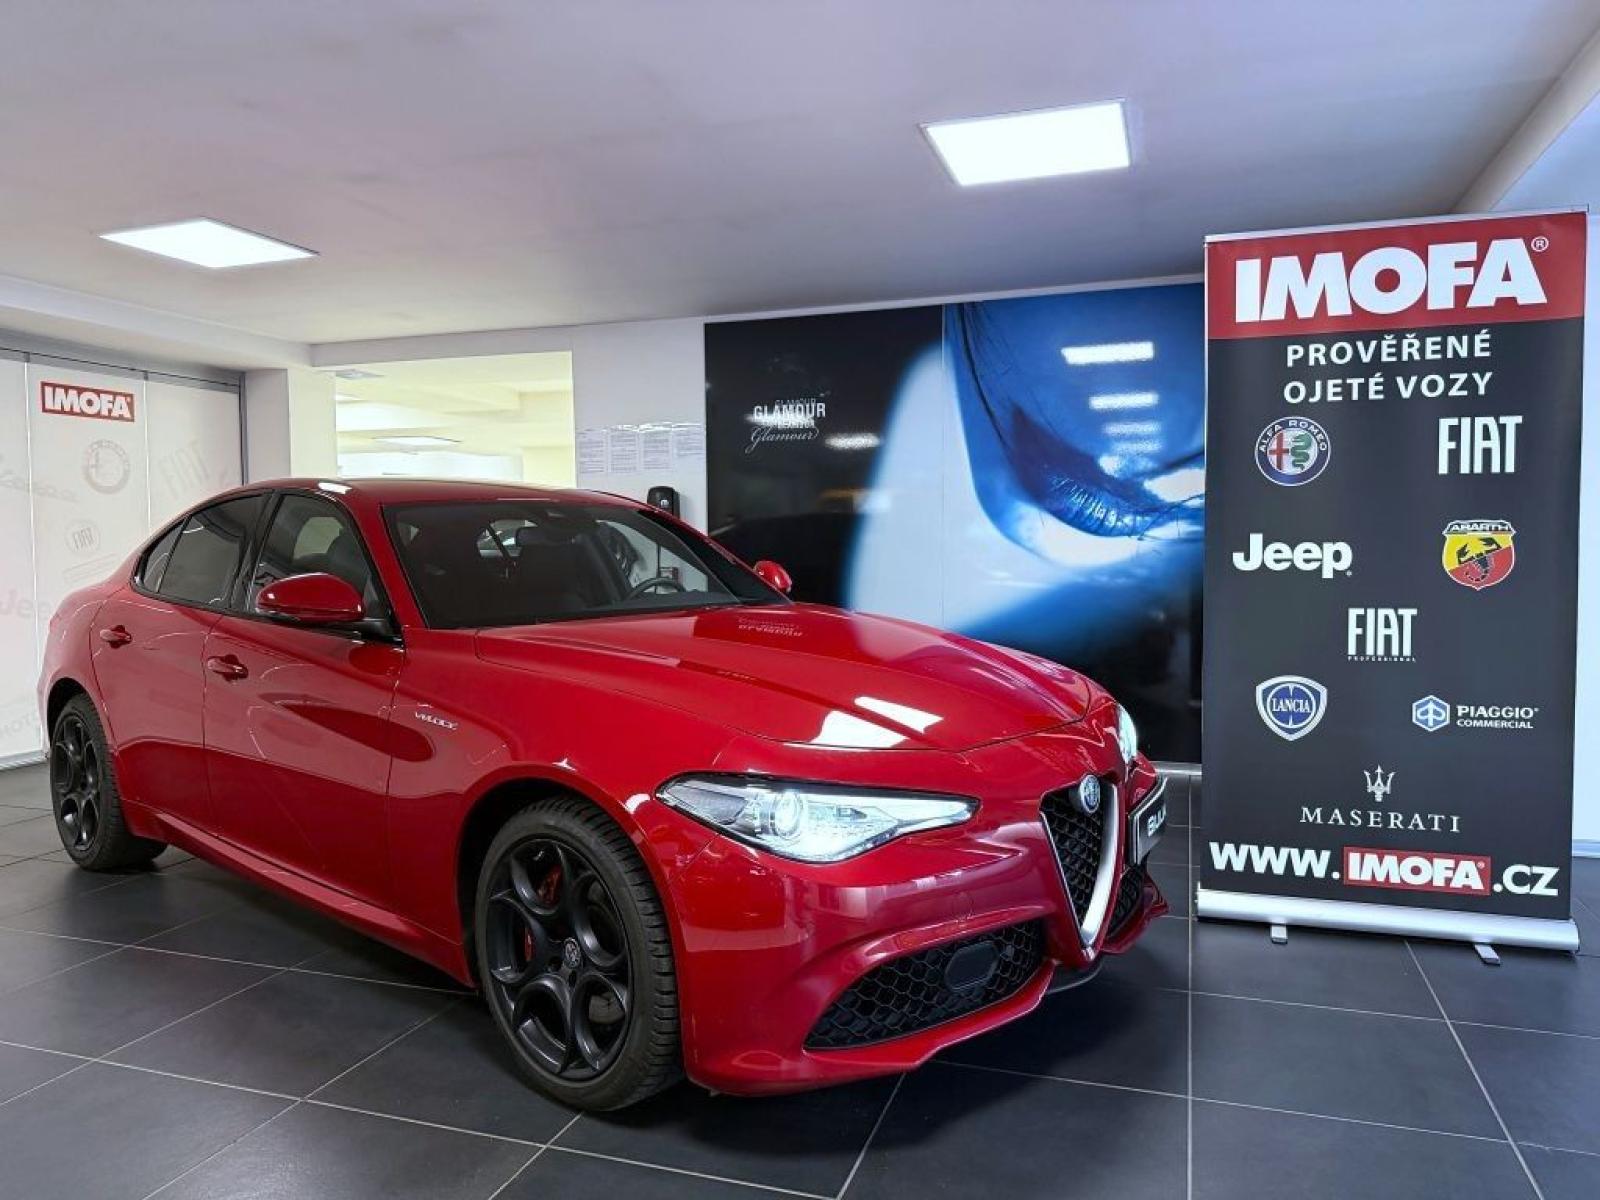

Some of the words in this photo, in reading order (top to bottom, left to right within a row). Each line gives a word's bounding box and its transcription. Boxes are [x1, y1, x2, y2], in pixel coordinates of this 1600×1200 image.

[1235, 238, 1548, 323] IMOFA
[1286, 329, 1492, 368] PROVĚŘENÉ
[44, 385, 131, 418] IMOFA
[1283, 374, 1385, 404] OJETÉ
[1396, 371, 1493, 399] VOZY
[1288, 420, 1328, 450] ROMEO
[1438, 415, 1523, 475] FIAT
[1232, 532, 1353, 579] Jeep
[1347, 608, 1418, 656] FIAT
[1271, 697, 1312, 713] LANCIA
[1456, 705, 1534, 720] PIAGGIO
[1456, 718, 1534, 729] COMMERCIAL
[1299, 806, 1462, 833] MASERATI
